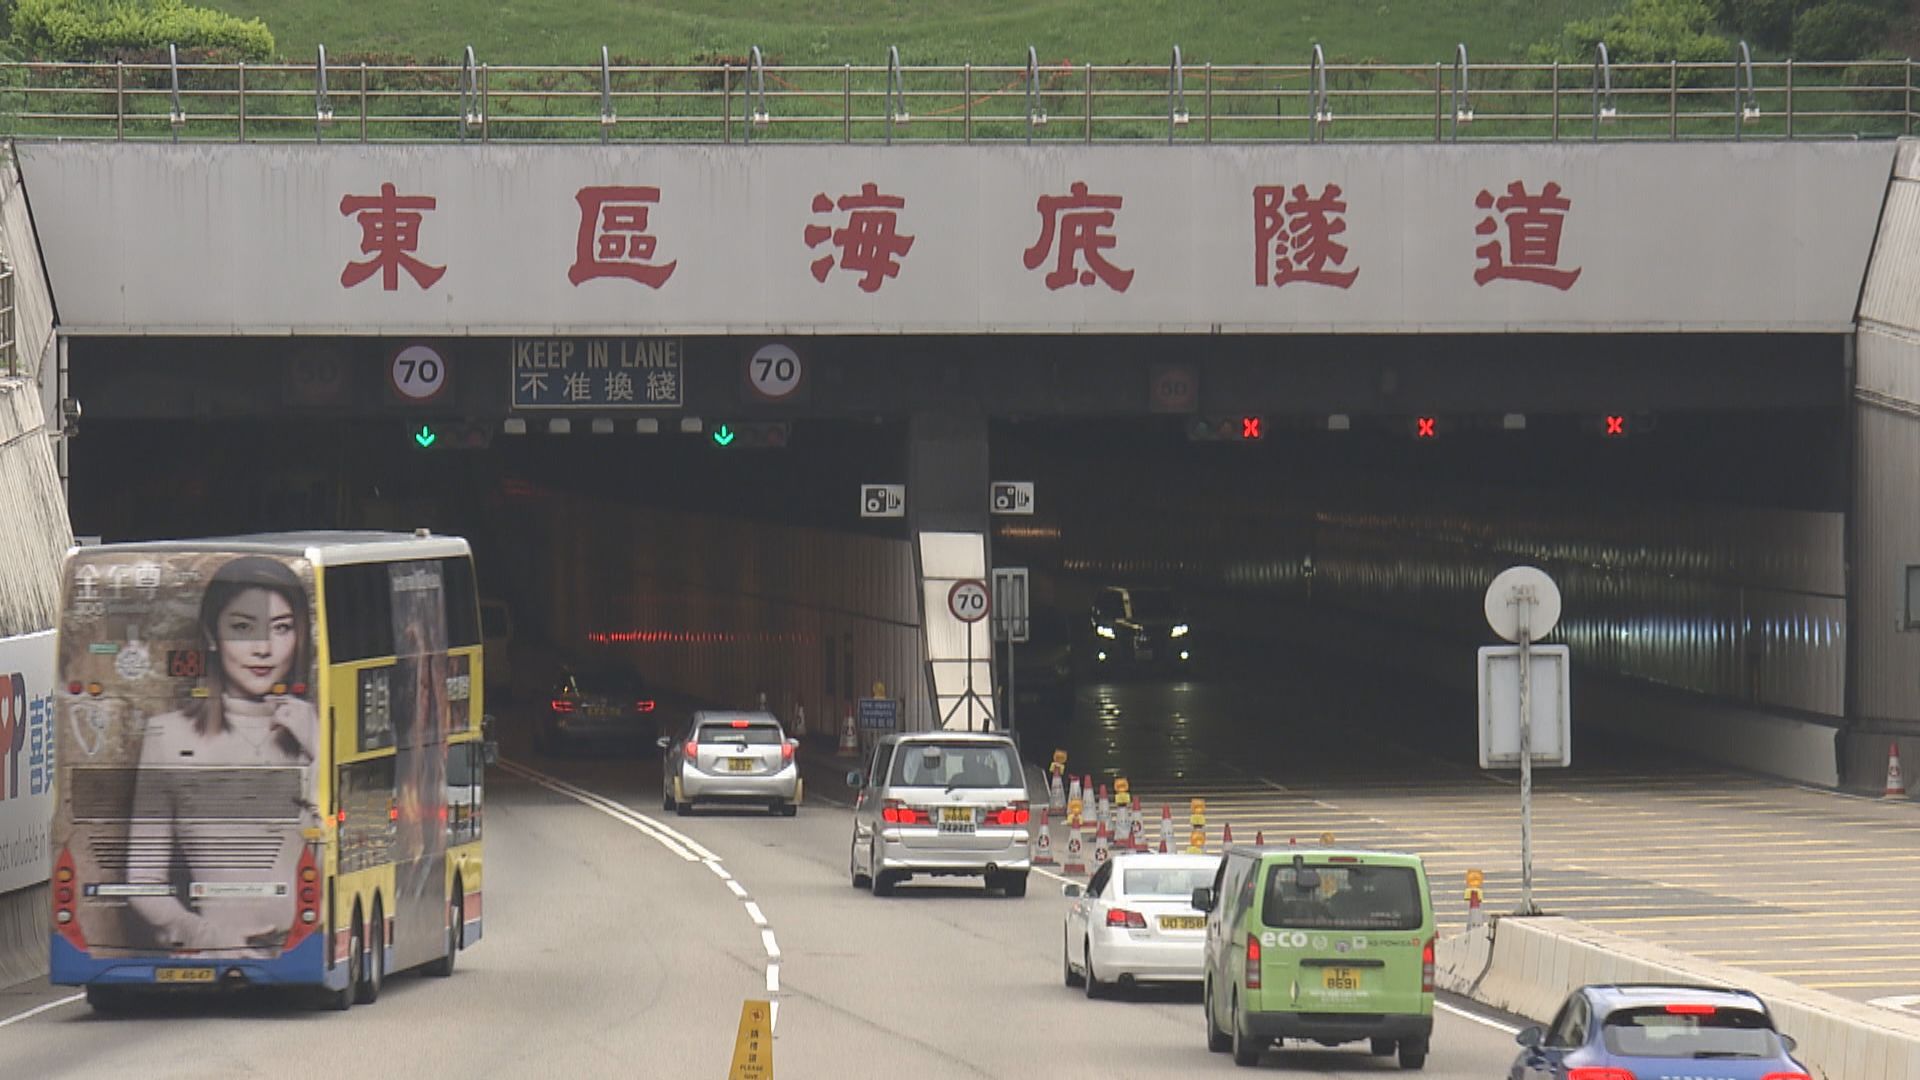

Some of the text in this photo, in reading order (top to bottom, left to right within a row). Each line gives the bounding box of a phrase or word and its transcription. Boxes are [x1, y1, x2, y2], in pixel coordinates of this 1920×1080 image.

[341, 183, 1581, 290] 東區海底隧道
[518, 342, 678, 369] KEEP IN LANE
[399, 360, 439, 384] 70
[756, 358, 795, 382] 70
[520, 372, 677, 401] 不准換綫
[957, 593, 984, 610] 70
[1260, 932, 1308, 948] eco
